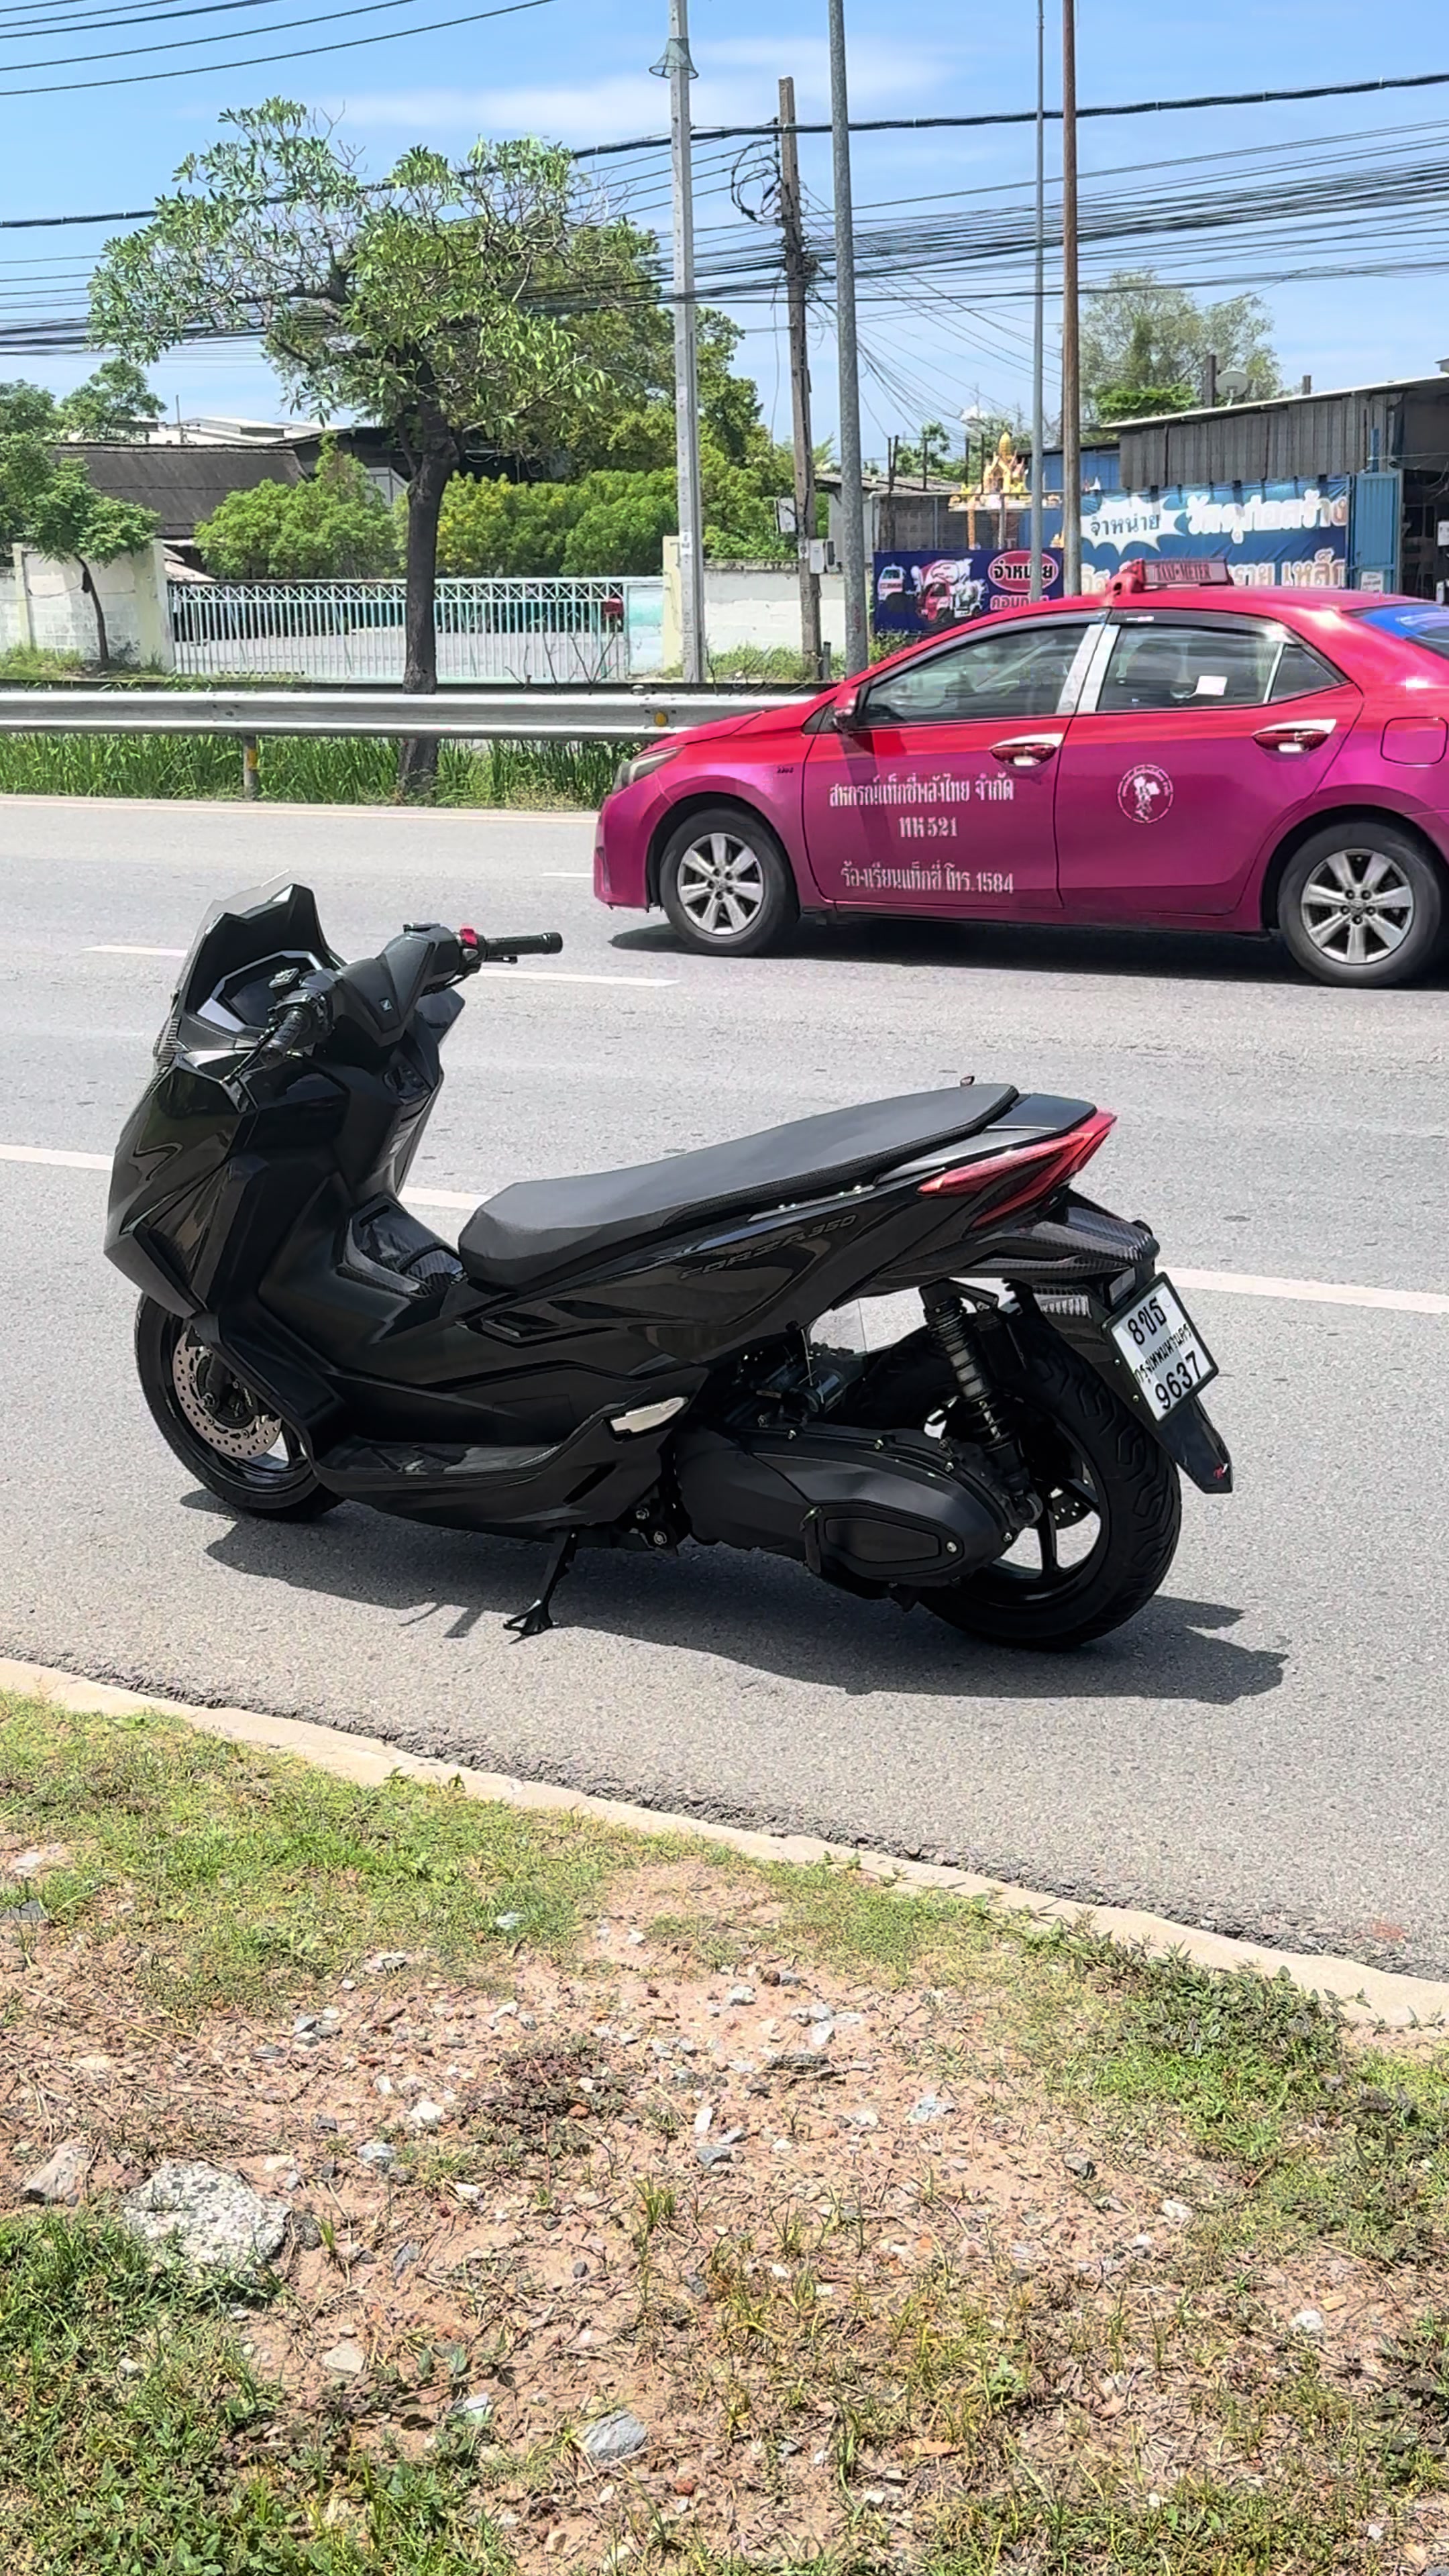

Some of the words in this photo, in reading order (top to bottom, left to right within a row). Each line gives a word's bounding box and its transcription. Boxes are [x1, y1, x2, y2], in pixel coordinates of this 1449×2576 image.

[1090, 513, 1160, 536] จำหน่าย
[994, 559, 1053, 579] จำหนย
[1227, 562, 1275, 586] ราย
[975, 771, 1014, 801] จำกัด
[927, 816, 959, 837] 521
[807, 1214, 857, 1238] 350
[1127, 1297, 1167, 1346] 8ขธ
[1134, 1322, 1192, 1385] กรุงเทพมหานคร
[1155, 1350, 1201, 1409] 9637
